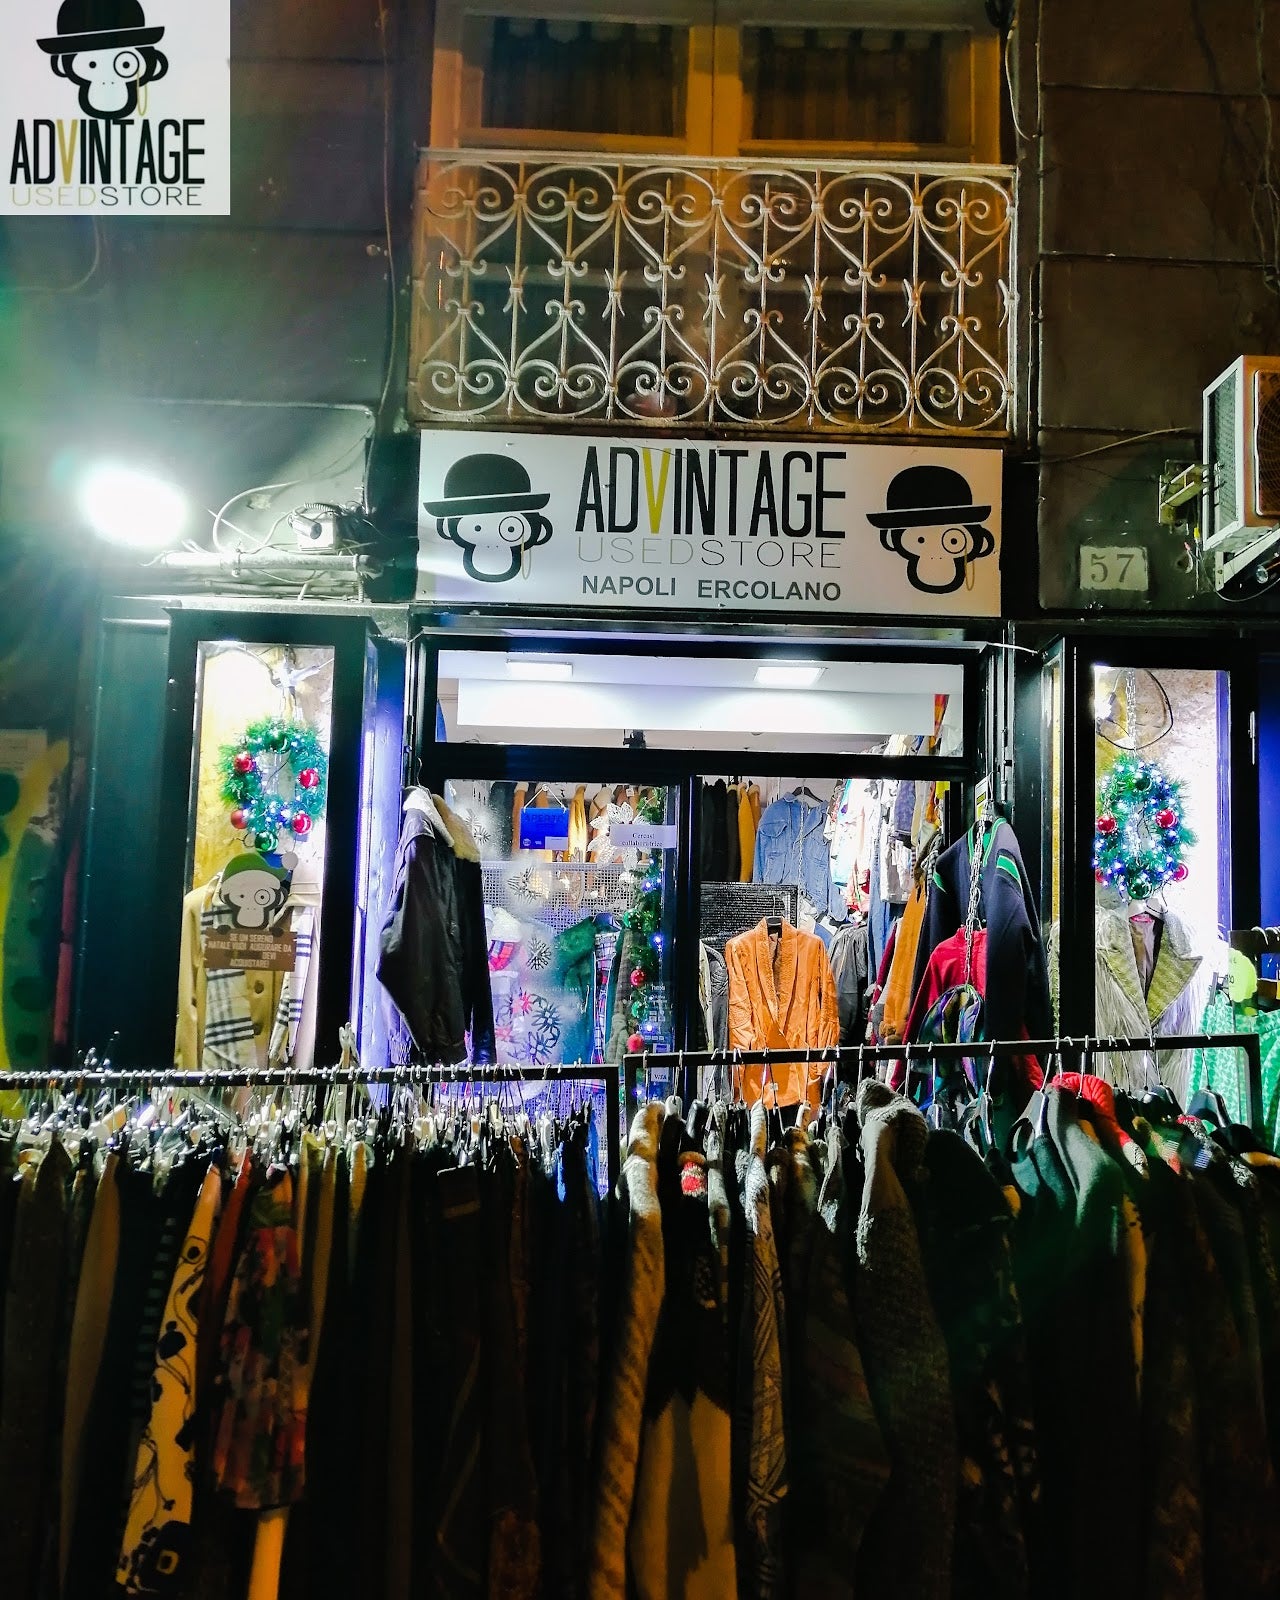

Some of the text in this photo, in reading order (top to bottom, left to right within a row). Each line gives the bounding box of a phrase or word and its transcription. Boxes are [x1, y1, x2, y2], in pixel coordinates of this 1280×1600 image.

[575, 446, 846, 538] ADVINTAGE
[1091, 553, 1134, 582] 57
[582, 575, 841, 601] NAPOLI ERCOLANO
[208, 941, 230, 949] NATALE
